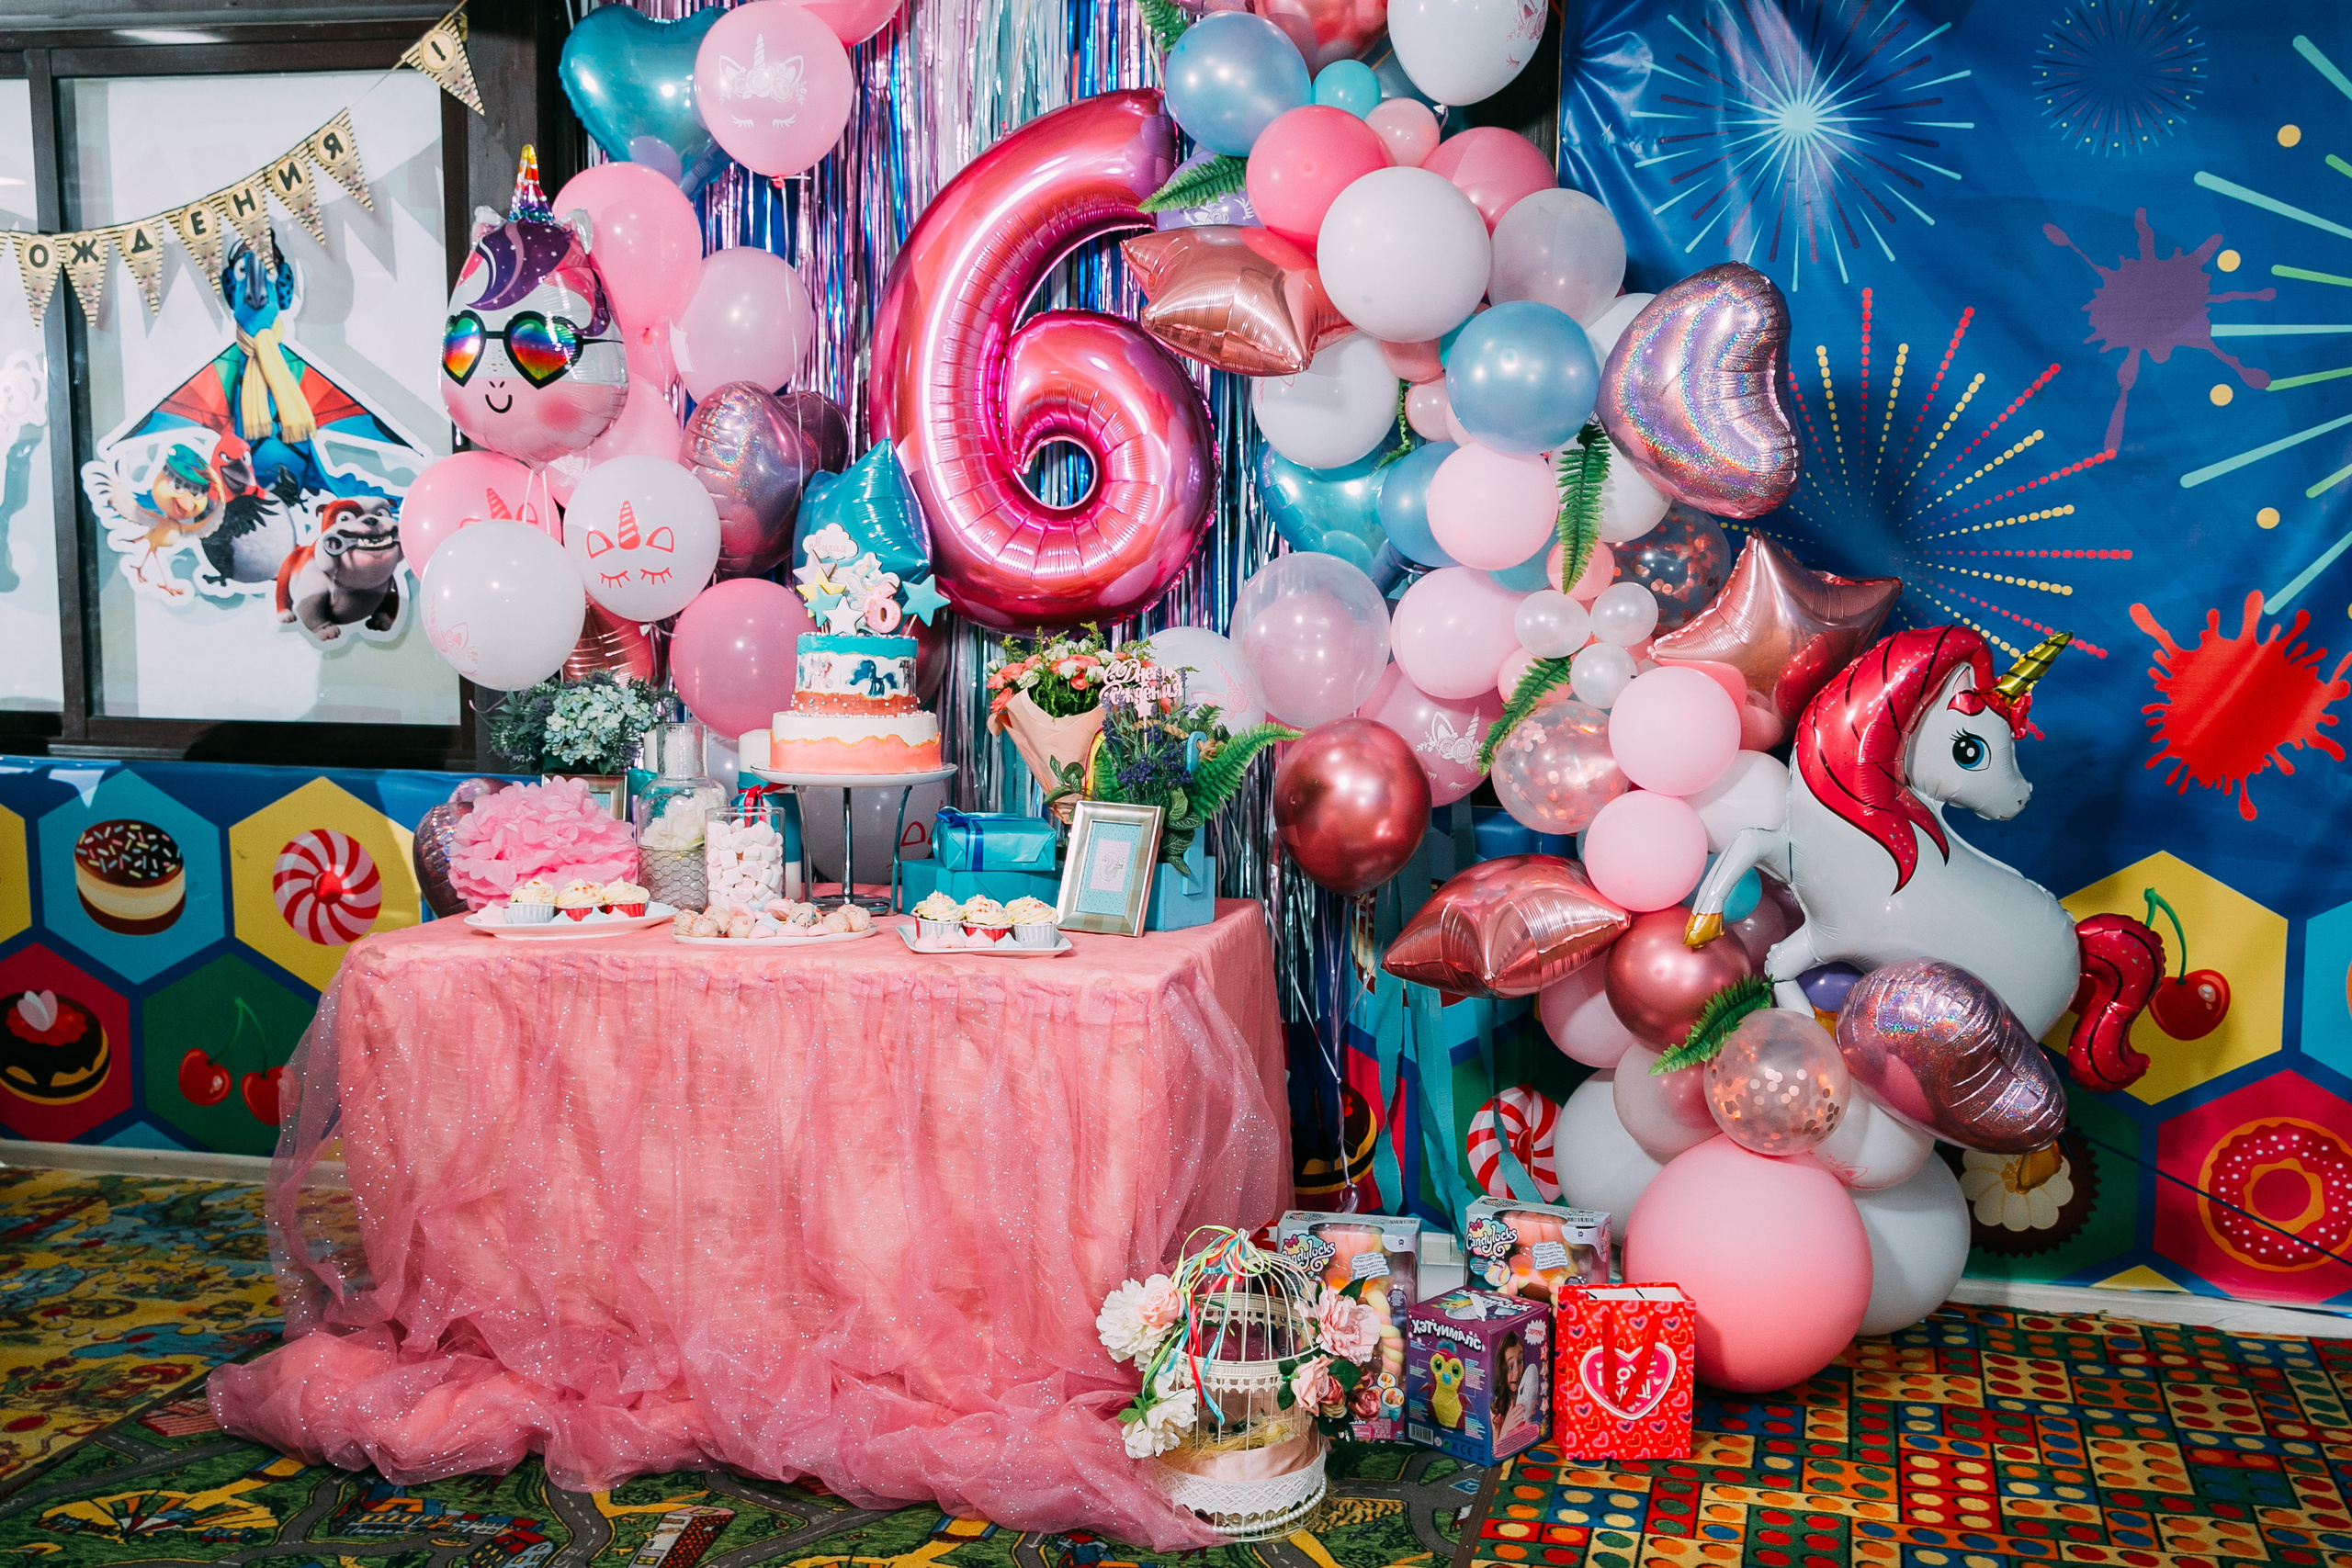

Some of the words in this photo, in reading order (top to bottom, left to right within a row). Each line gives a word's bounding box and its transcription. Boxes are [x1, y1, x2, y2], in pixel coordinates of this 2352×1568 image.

[870, 87, 1221, 635] 6
[863, 581, 902, 634] 6
[1466, 1224, 1518, 1257] Candylocks
[1411, 1319, 1483, 1351] ХЭТЧИМАЛС
